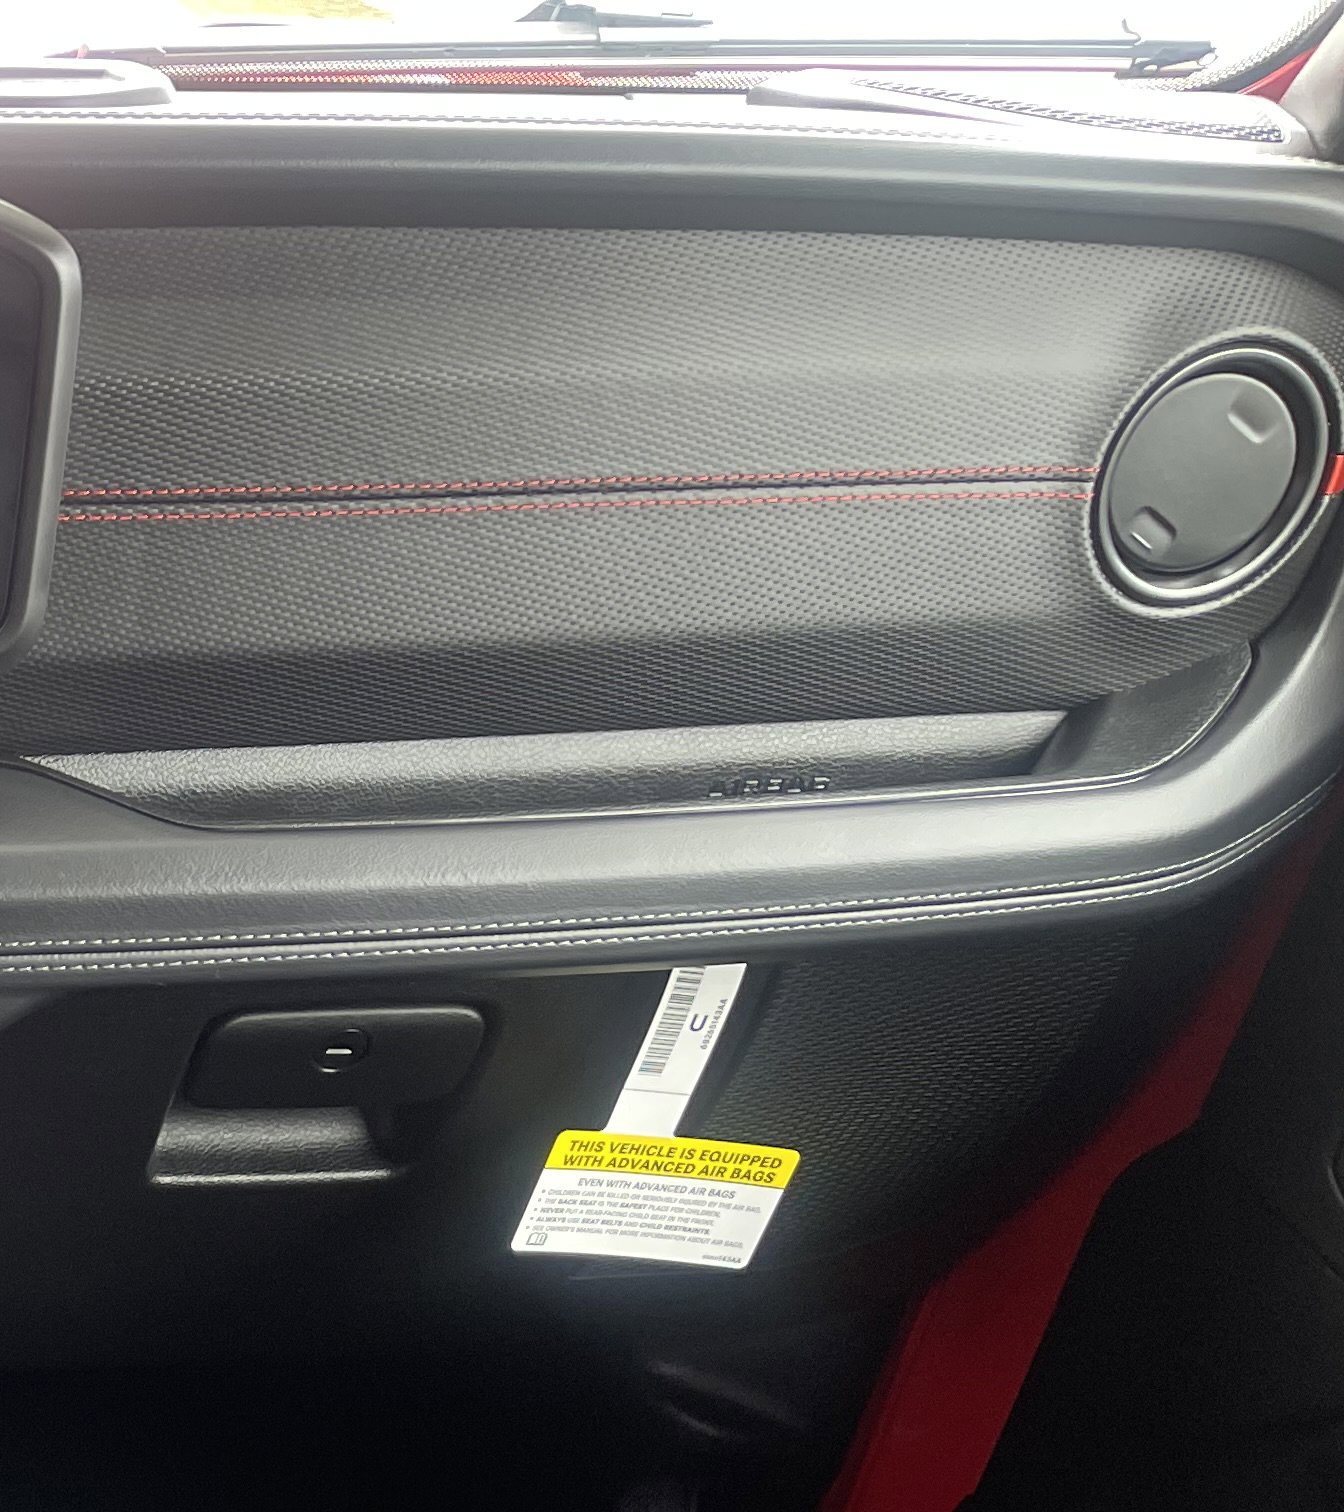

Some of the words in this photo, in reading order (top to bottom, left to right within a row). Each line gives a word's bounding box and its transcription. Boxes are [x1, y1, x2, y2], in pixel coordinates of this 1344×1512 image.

[690, 1013, 708, 1032] U
[570, 1140, 605, 1152] THIS
[610, 1141, 676, 1158] VEHICLE
[679, 1148, 696, 1160] IS
[698, 1149, 782, 1169] EQUIPPED
[563, 1155, 603, 1167] WITH
[606, 1157, 696, 1174] ADVANCED
[698, 1166, 726, 1178] AIR
[729, 1168, 776, 1184] BAGS
[578, 1178, 603, 1188] EVEN
[606, 1179, 631, 1189] WITH
[633, 1181, 687, 1194] ADVANCED
[688, 1186, 707, 1196] AIR
[708, 1188, 736, 1199] BAGS
